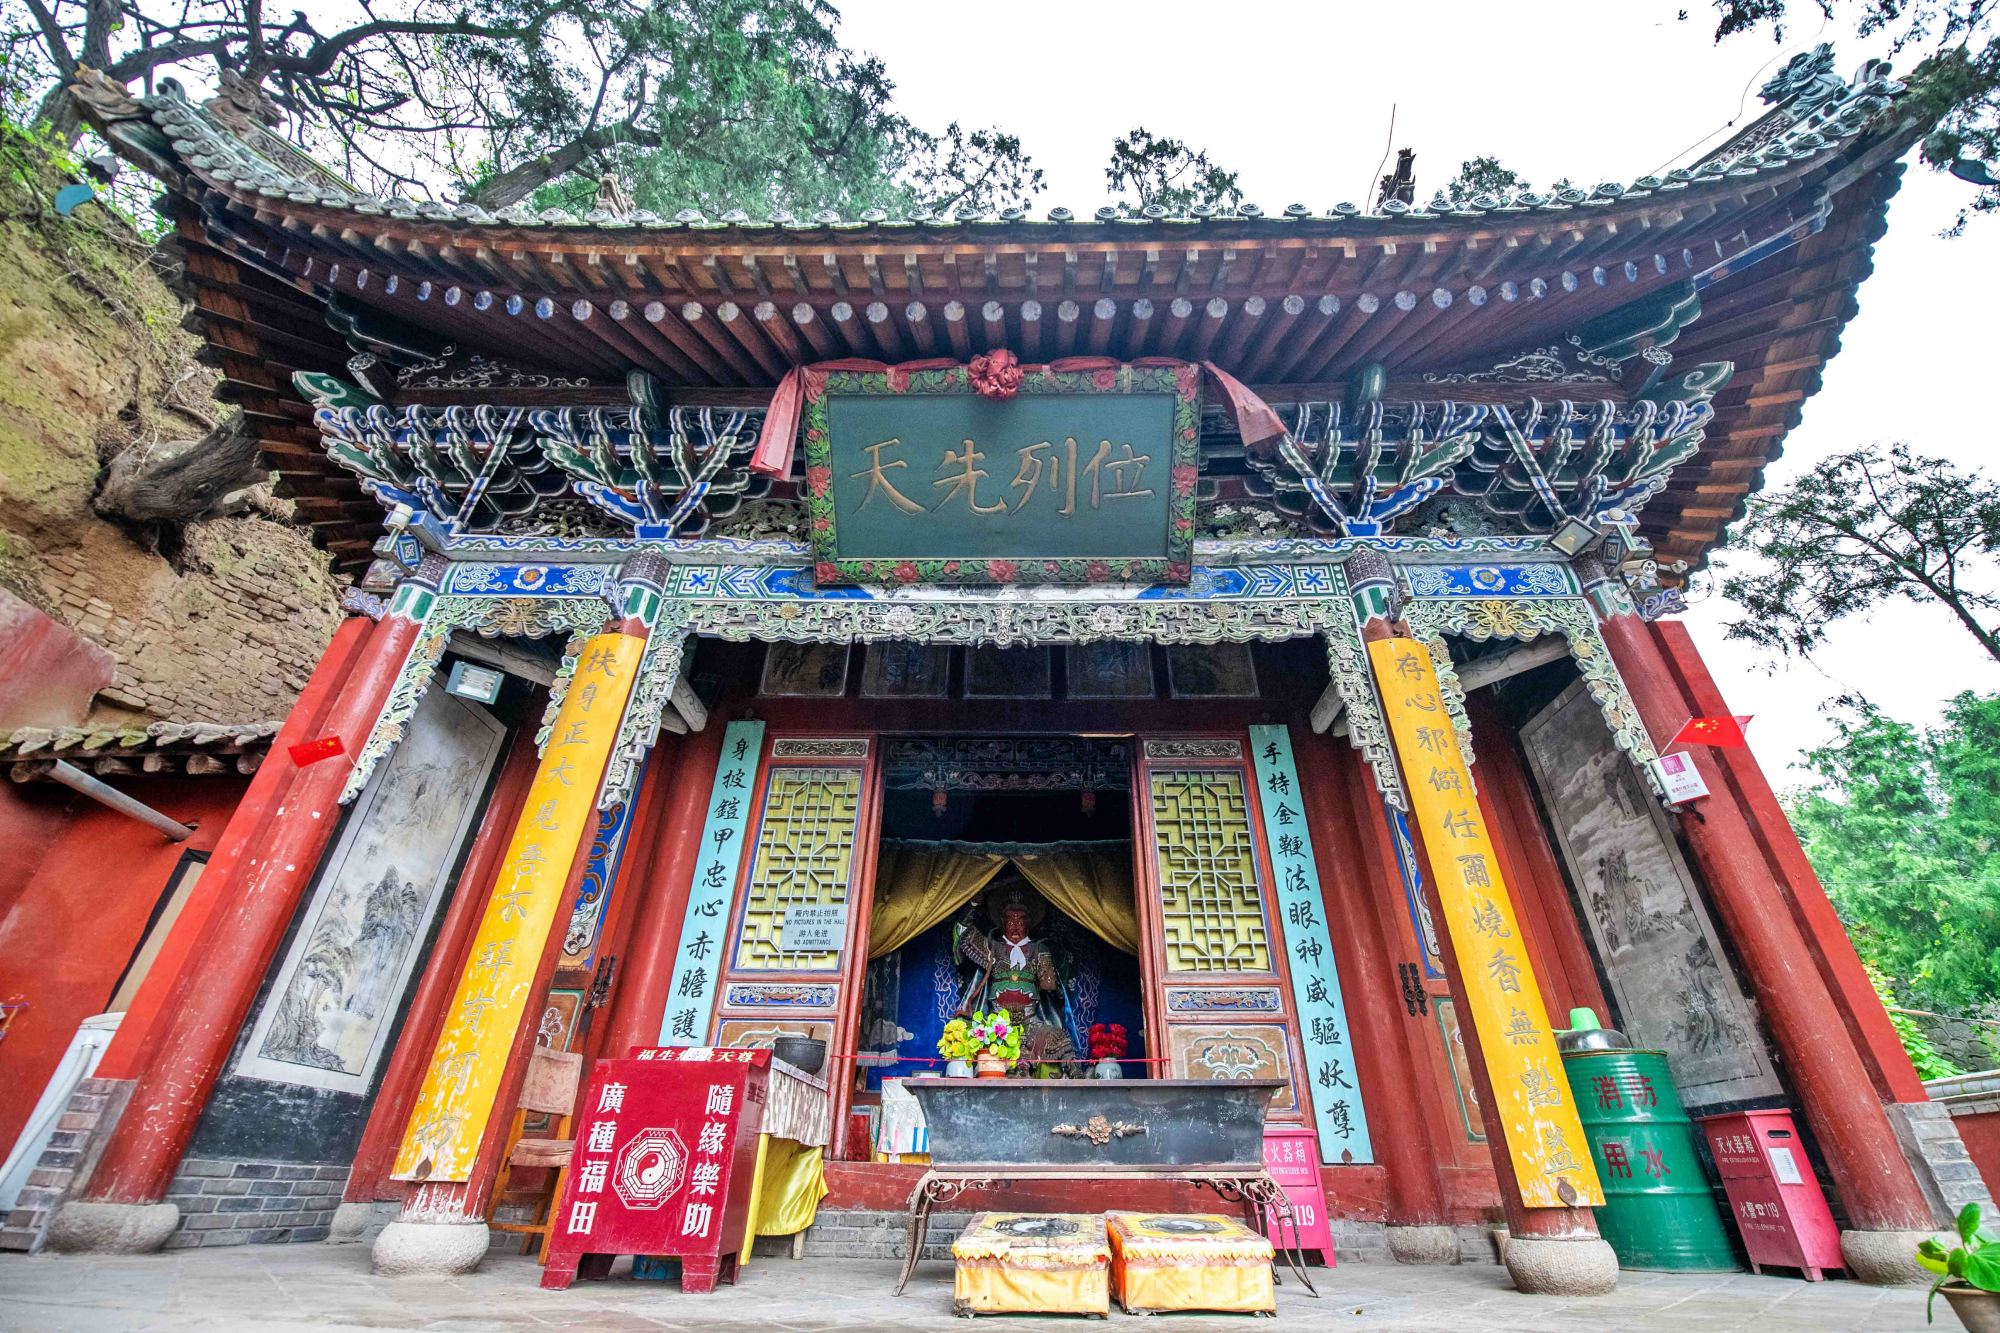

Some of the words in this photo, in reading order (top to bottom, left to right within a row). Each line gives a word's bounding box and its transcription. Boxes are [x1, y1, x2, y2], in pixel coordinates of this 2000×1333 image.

[802, 938, 832, 946] ADMITTANCE
[1262, 741, 1356, 1139] 手持金鞭法眼神威驅妖孽
[1591, 1073, 1658, 1110] 消防
[566, 1082, 629, 1235] 廣種福田
[681, 1083, 736, 1238] 隨緣樂助
[1601, 1142, 1672, 1179] 用水
[1715, 1133, 1756, 1154] 灭火器箱
